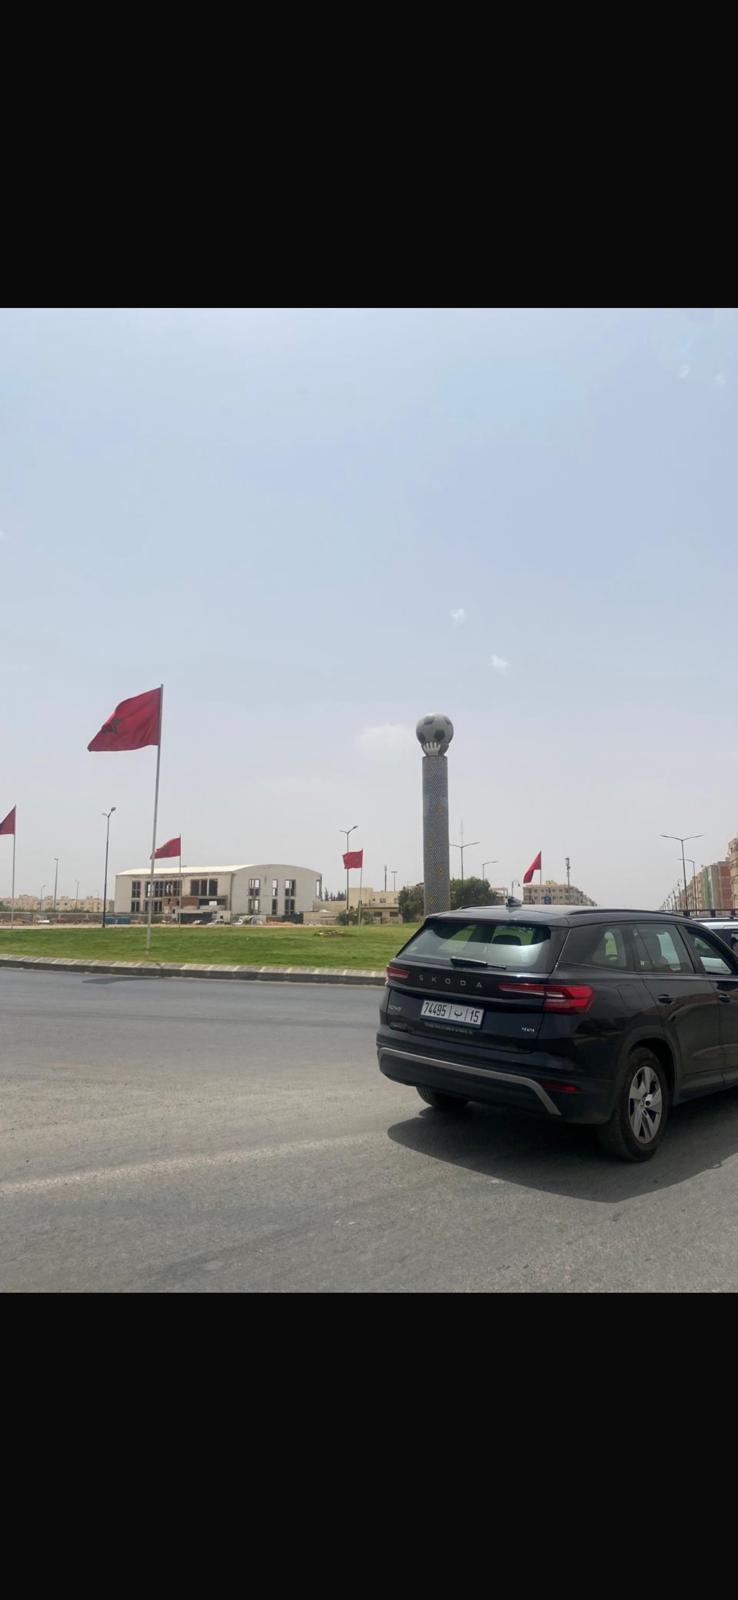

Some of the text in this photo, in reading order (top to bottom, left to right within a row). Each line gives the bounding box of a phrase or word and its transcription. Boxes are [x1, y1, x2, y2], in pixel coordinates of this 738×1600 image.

[419, 974, 482, 988] SKODA
[423, 1002, 447, 1017] 74495
[470, 1009, 480, 1023] 15
